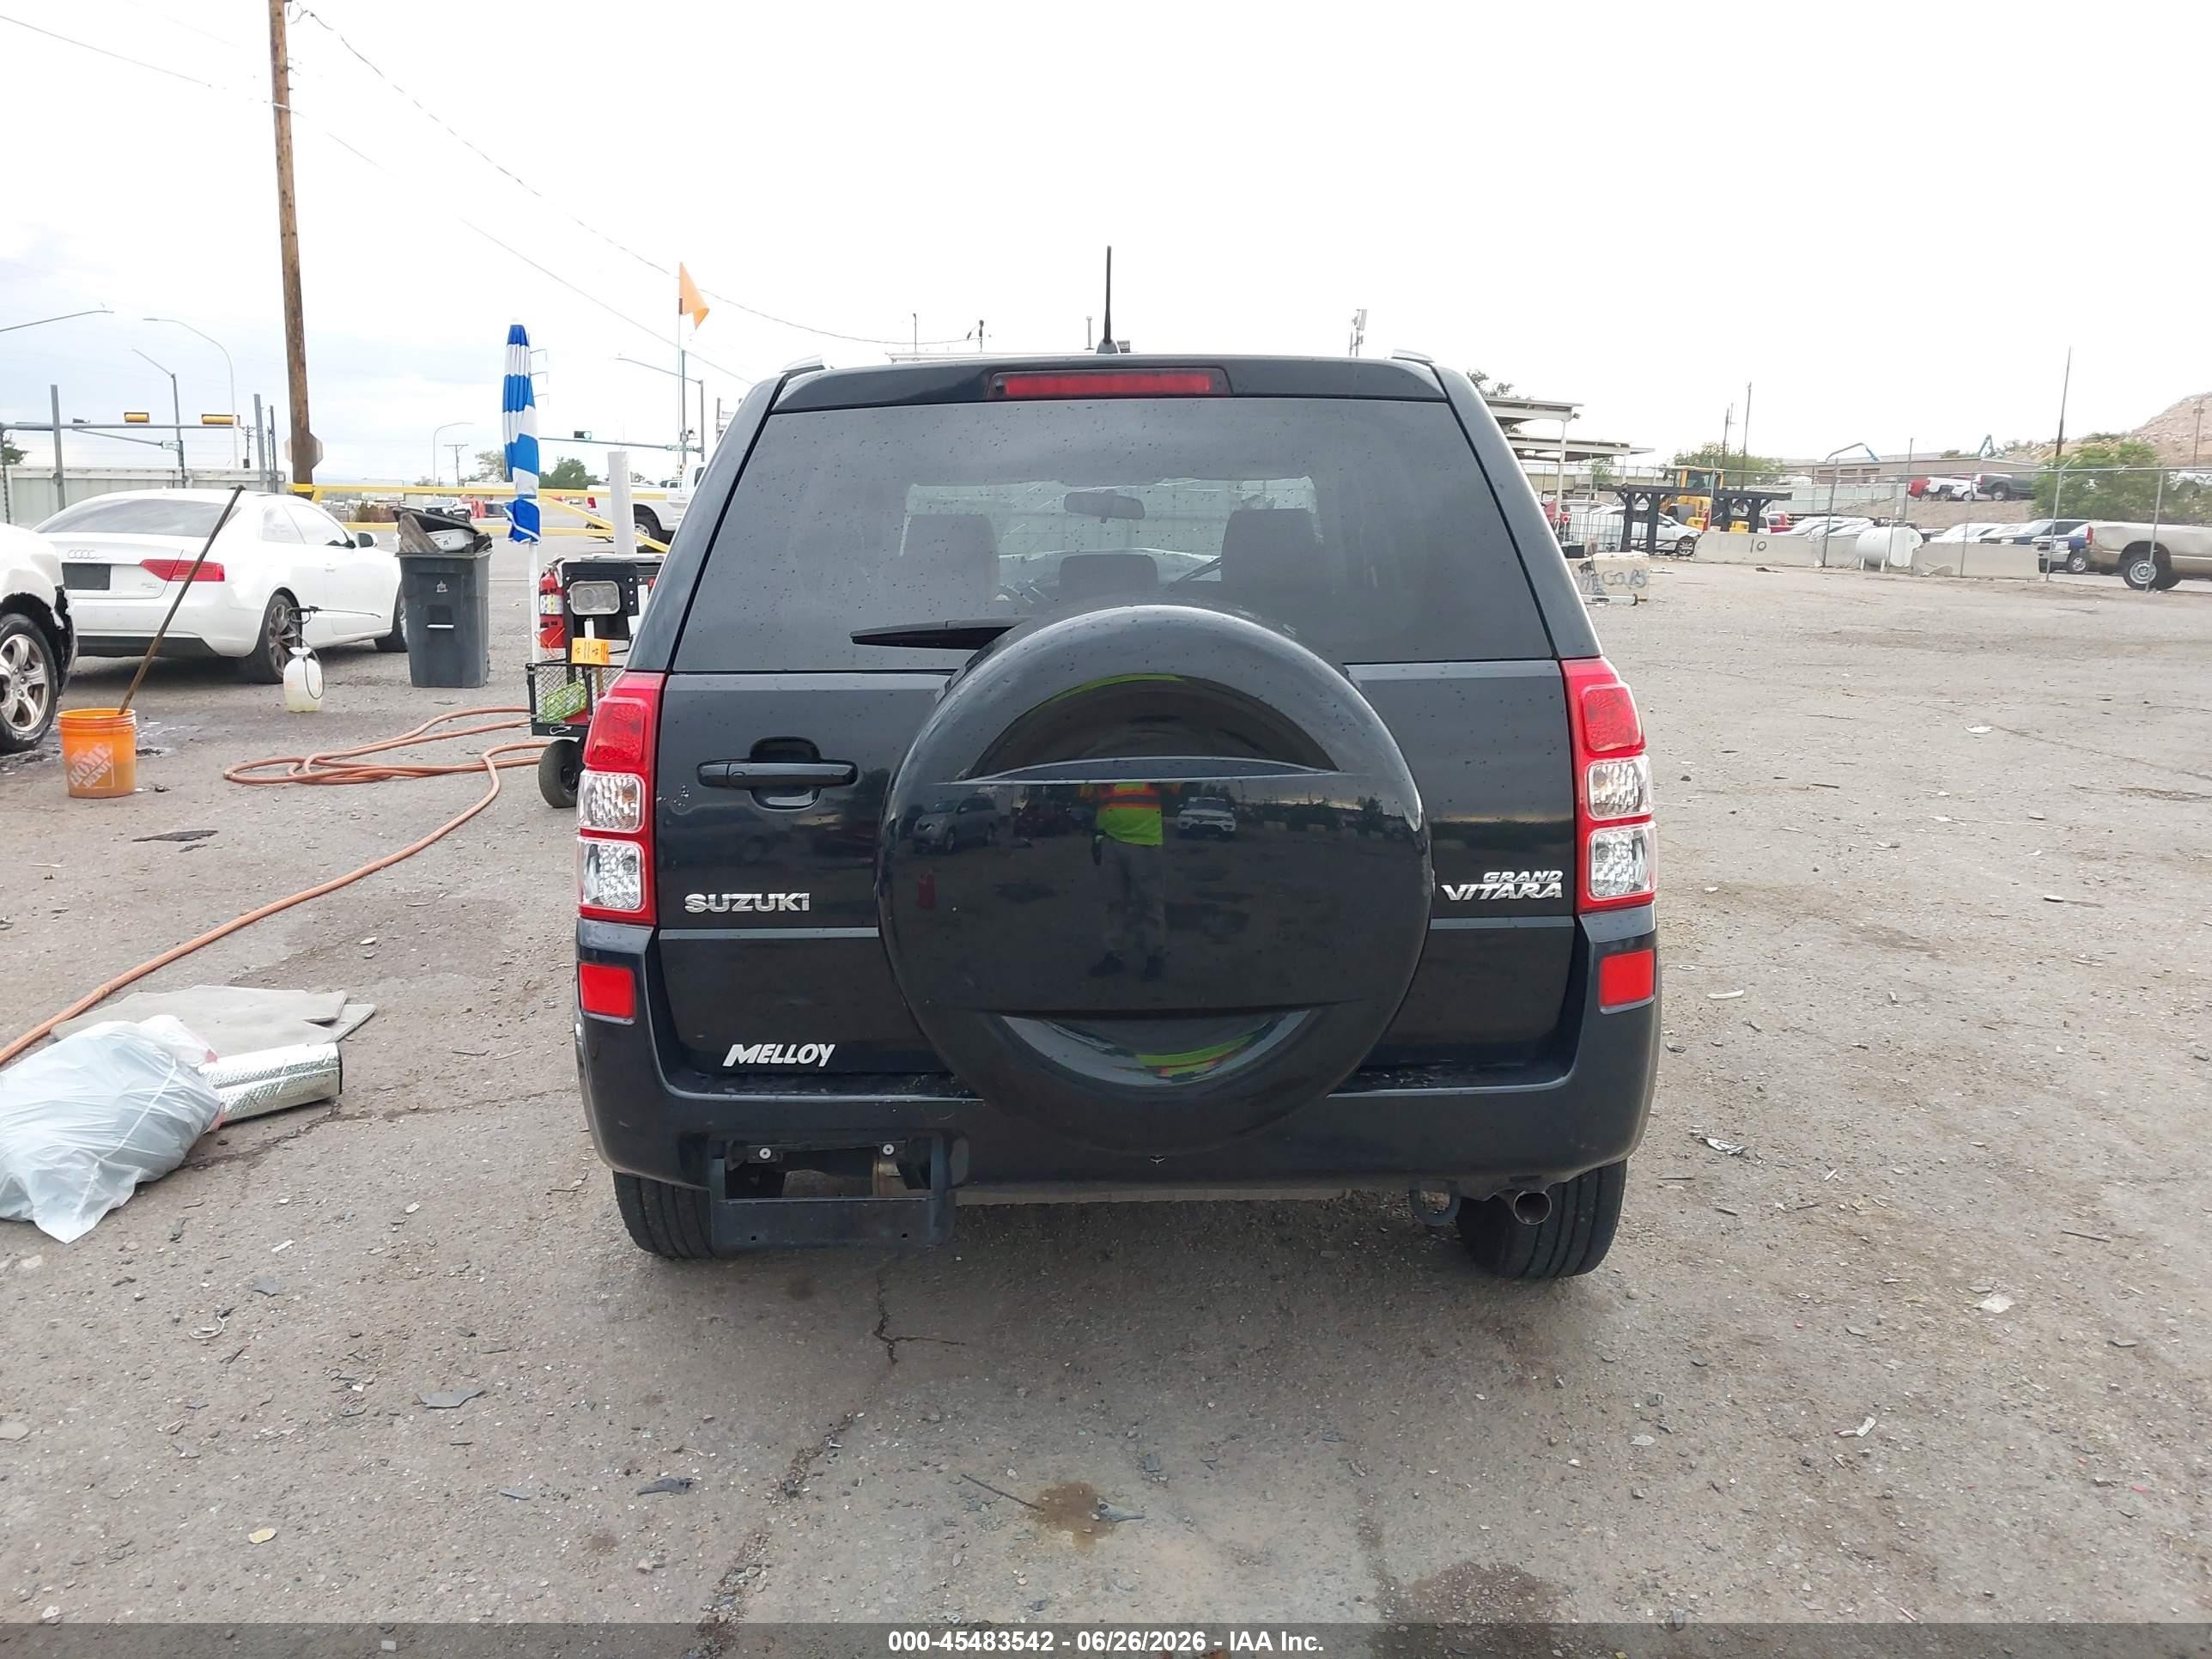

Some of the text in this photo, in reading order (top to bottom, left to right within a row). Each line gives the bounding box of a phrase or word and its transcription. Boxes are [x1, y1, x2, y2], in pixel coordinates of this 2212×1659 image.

[1750, 538, 1767, 553] 10
[1483, 871, 1563, 883] GRAND
[1441, 882, 1563, 901] VITARA
[684, 892, 811, 914] SUZUKI
[722, 1043, 836, 1067] MELLOY
